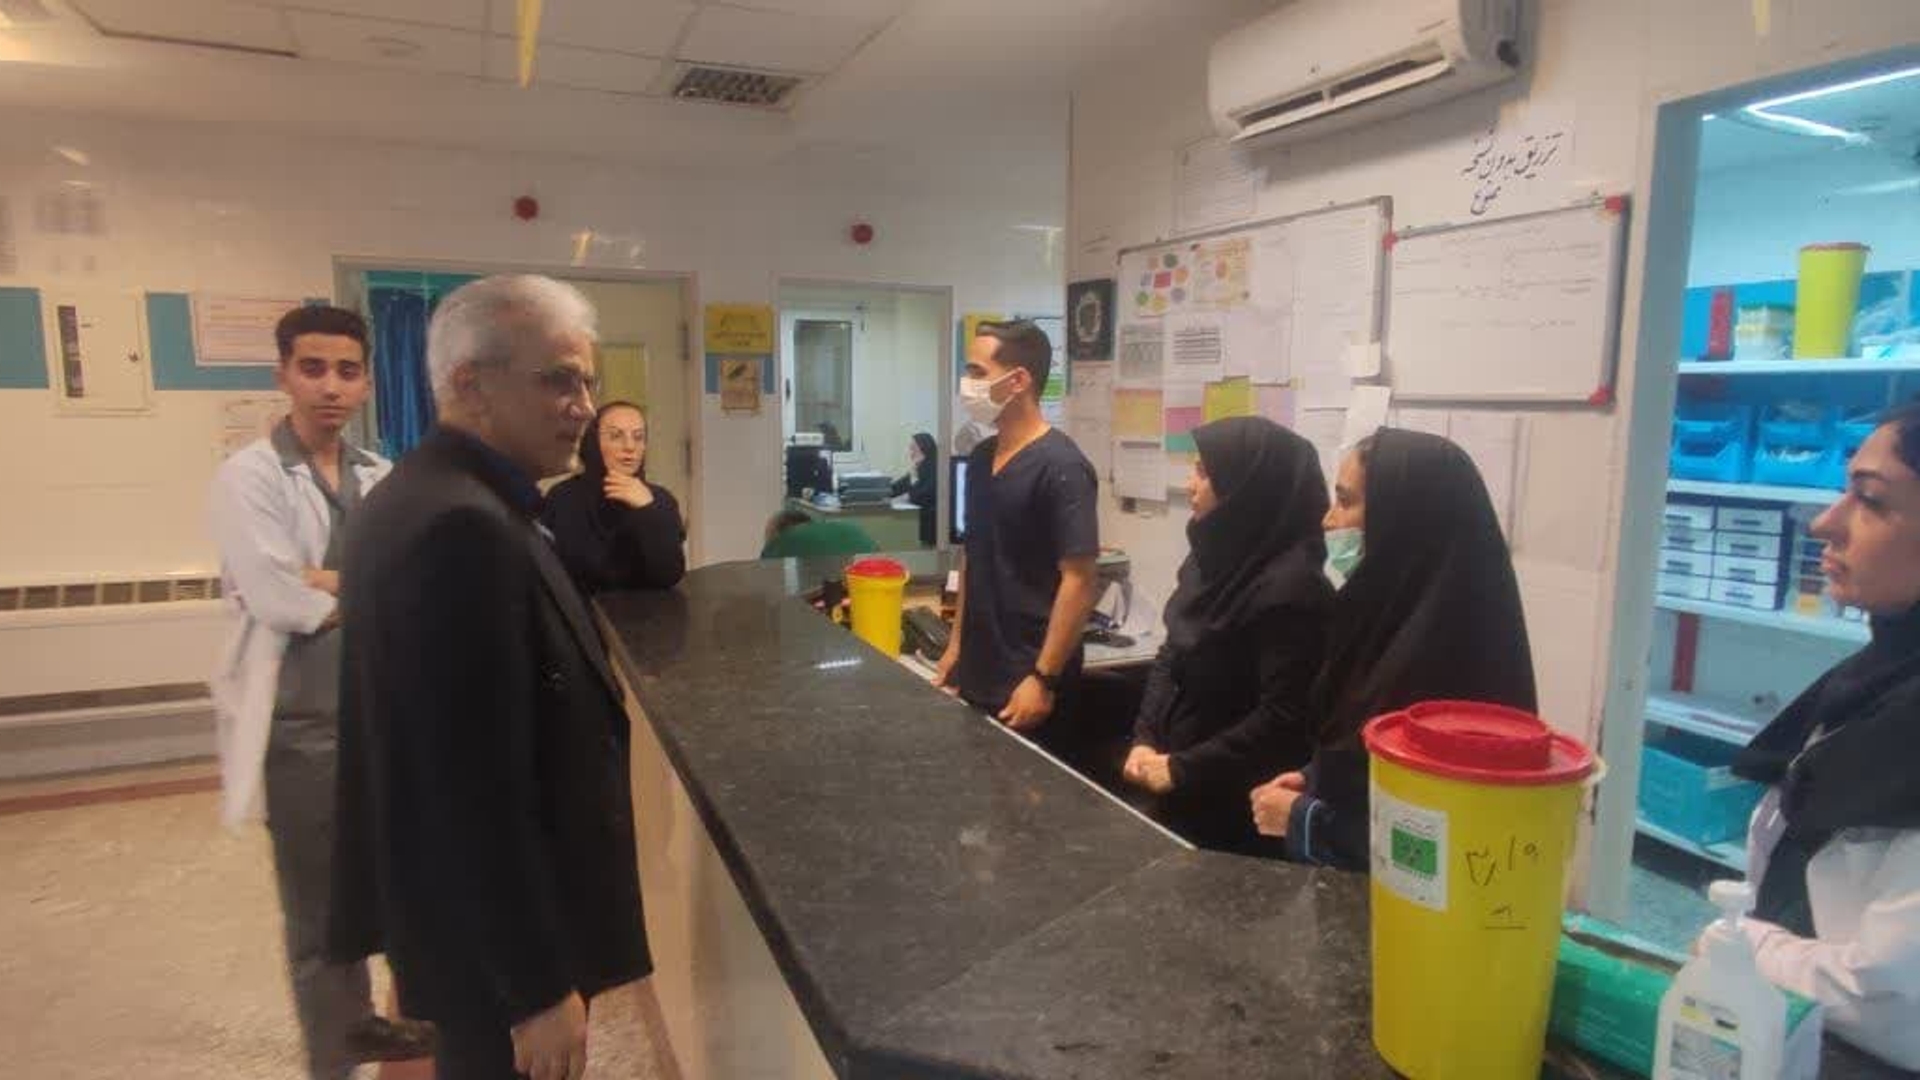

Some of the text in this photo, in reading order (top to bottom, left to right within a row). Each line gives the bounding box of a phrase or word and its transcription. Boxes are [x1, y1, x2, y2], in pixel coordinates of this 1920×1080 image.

[1460, 128, 1563, 181] تزریق بدون نسخه
